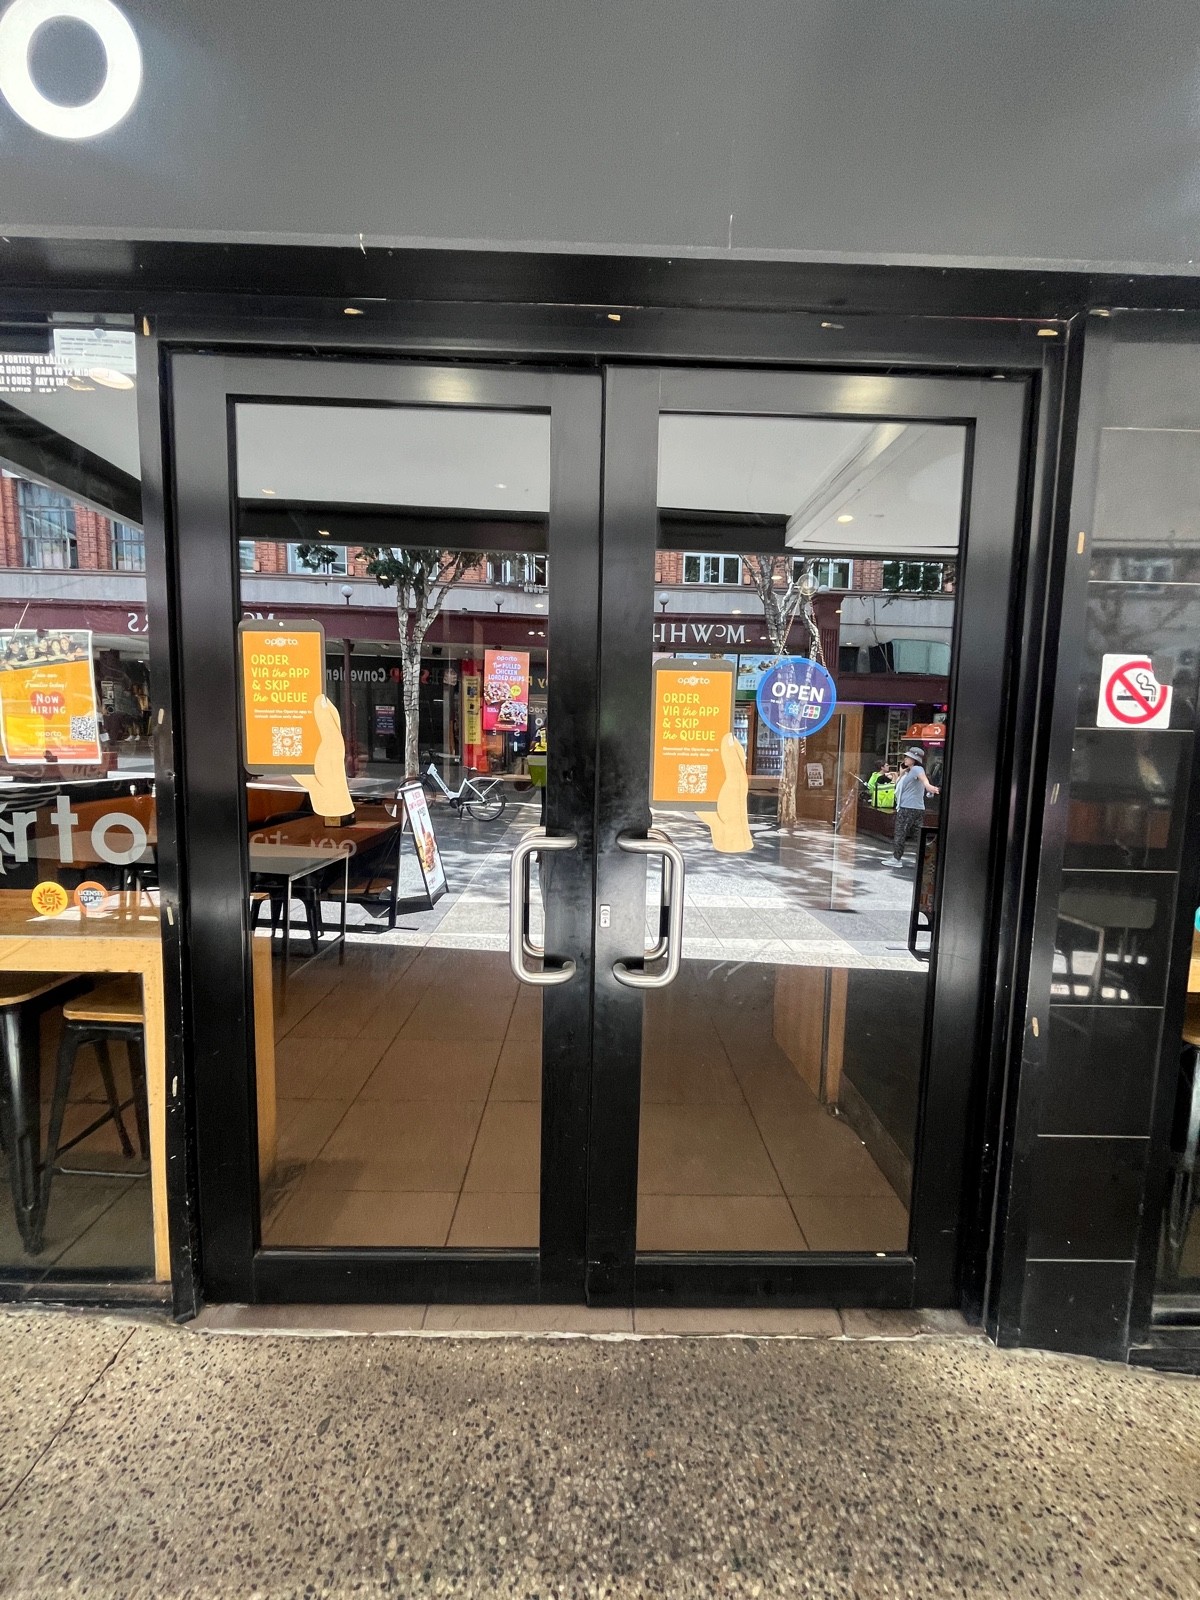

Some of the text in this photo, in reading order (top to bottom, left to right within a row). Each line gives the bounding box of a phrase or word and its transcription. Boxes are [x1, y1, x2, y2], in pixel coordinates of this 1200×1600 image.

[4, 354, 44, 364] FORTITUDE
[6, 366, 31, 374] HOURS
[251, 655, 289, 665] ORDER
[252, 668, 310, 678] VIA the APP
[252, 680, 290, 690] & SKIP
[772, 682, 824, 703] OPEN
[253, 693, 307, 703] the QUEUE
[663, 693, 700, 704] ORDER
[31, 706, 66, 715] HIRING
[663, 706, 719, 716] VIA the APP
[663, 718, 699, 728] & SKIP
[663, 730, 716, 741] the QUEUE
